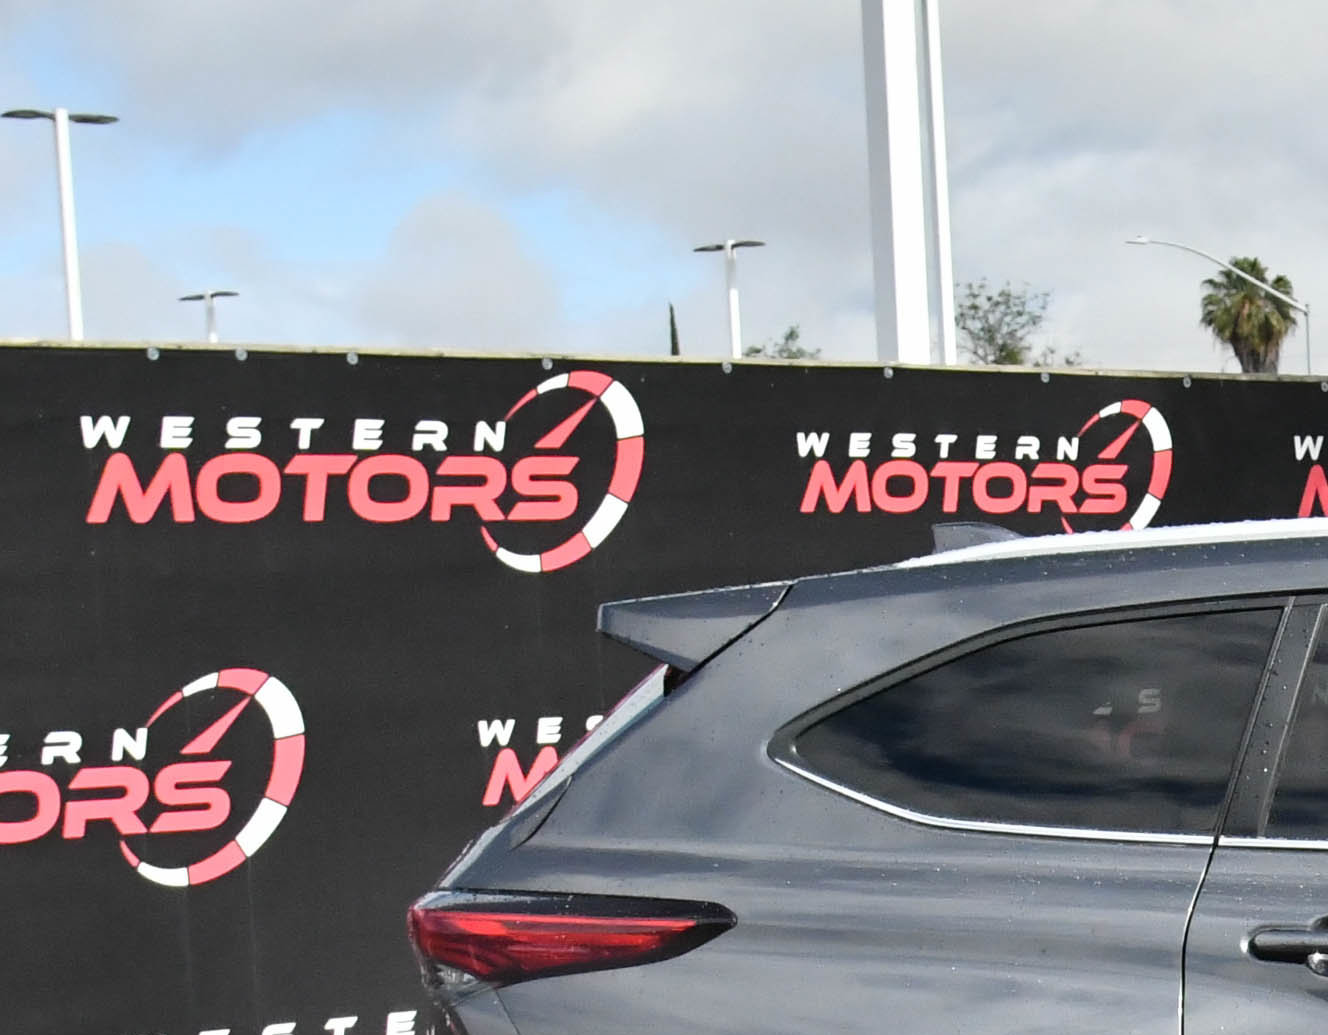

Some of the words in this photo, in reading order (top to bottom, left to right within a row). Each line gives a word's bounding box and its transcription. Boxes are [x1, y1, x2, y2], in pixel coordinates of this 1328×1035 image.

[79, 415, 508, 452] WESTERN
[796, 431, 1080, 461] WESTERN
[85, 452, 580, 524] MOTORS
[800, 459, 1129, 514] MOTORS
